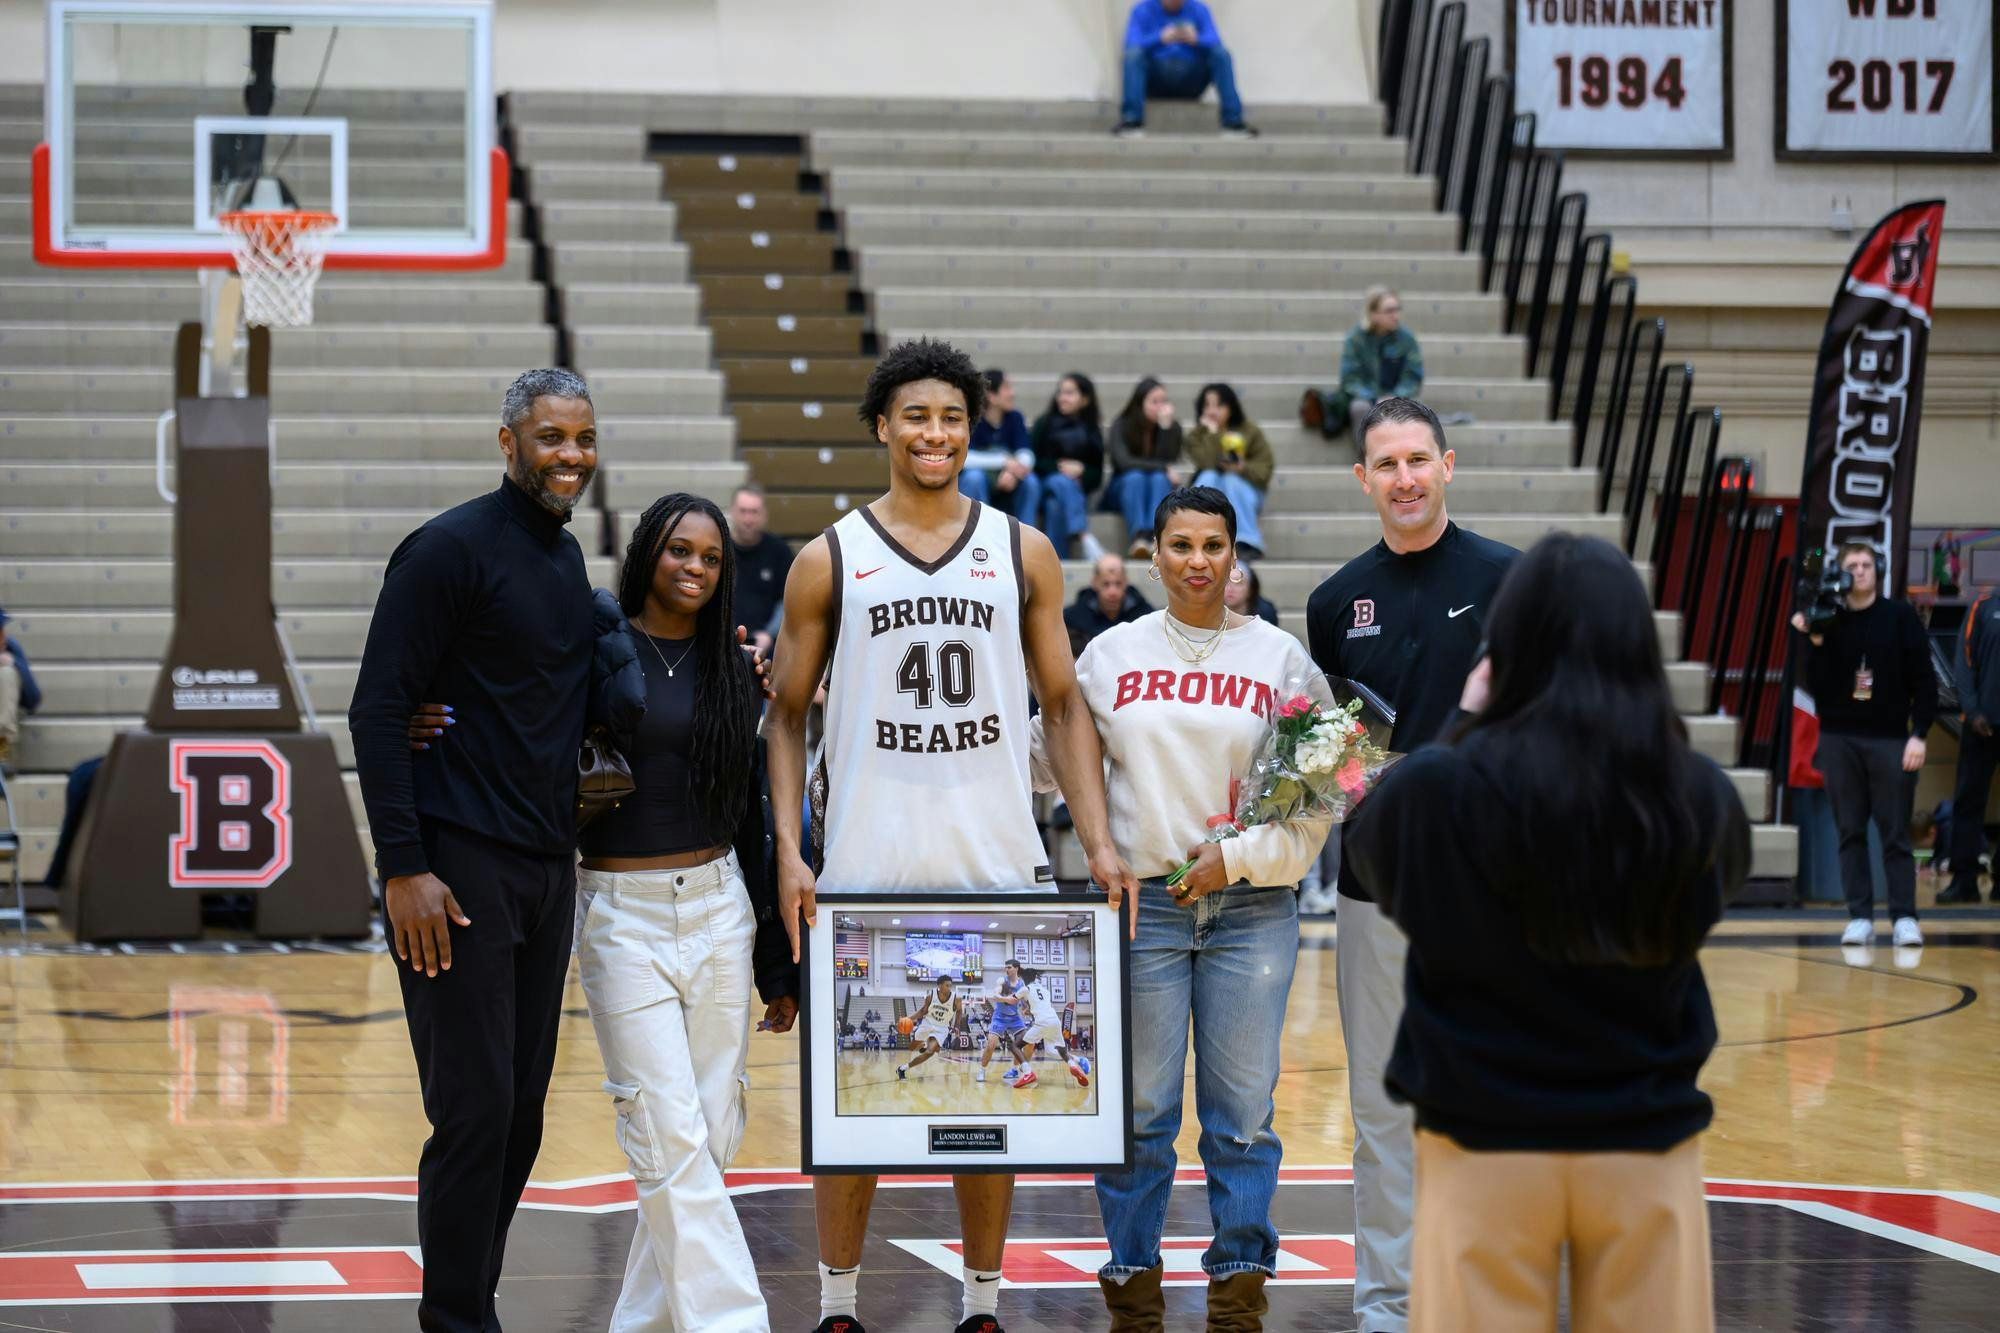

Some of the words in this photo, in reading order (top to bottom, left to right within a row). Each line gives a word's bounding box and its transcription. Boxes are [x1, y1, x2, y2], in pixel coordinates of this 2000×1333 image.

[1526, 0, 1715, 27] TOURNAMENT
[1554, 54, 1685, 110] 1994
[1826, 58, 1955, 114] 2017
[970, 569, 987, 579] Ivy
[869, 597, 994, 638] BROWN
[1353, 599, 1375, 628] B
[896, 640, 975, 709] 40
[1113, 669, 1278, 726] BROWN
[876, 714, 1000, 753] BEARS
[169, 739, 292, 888] B
[939, 1132, 965, 1140] LANDON
[966, 1132, 985, 1140] LEWIS
